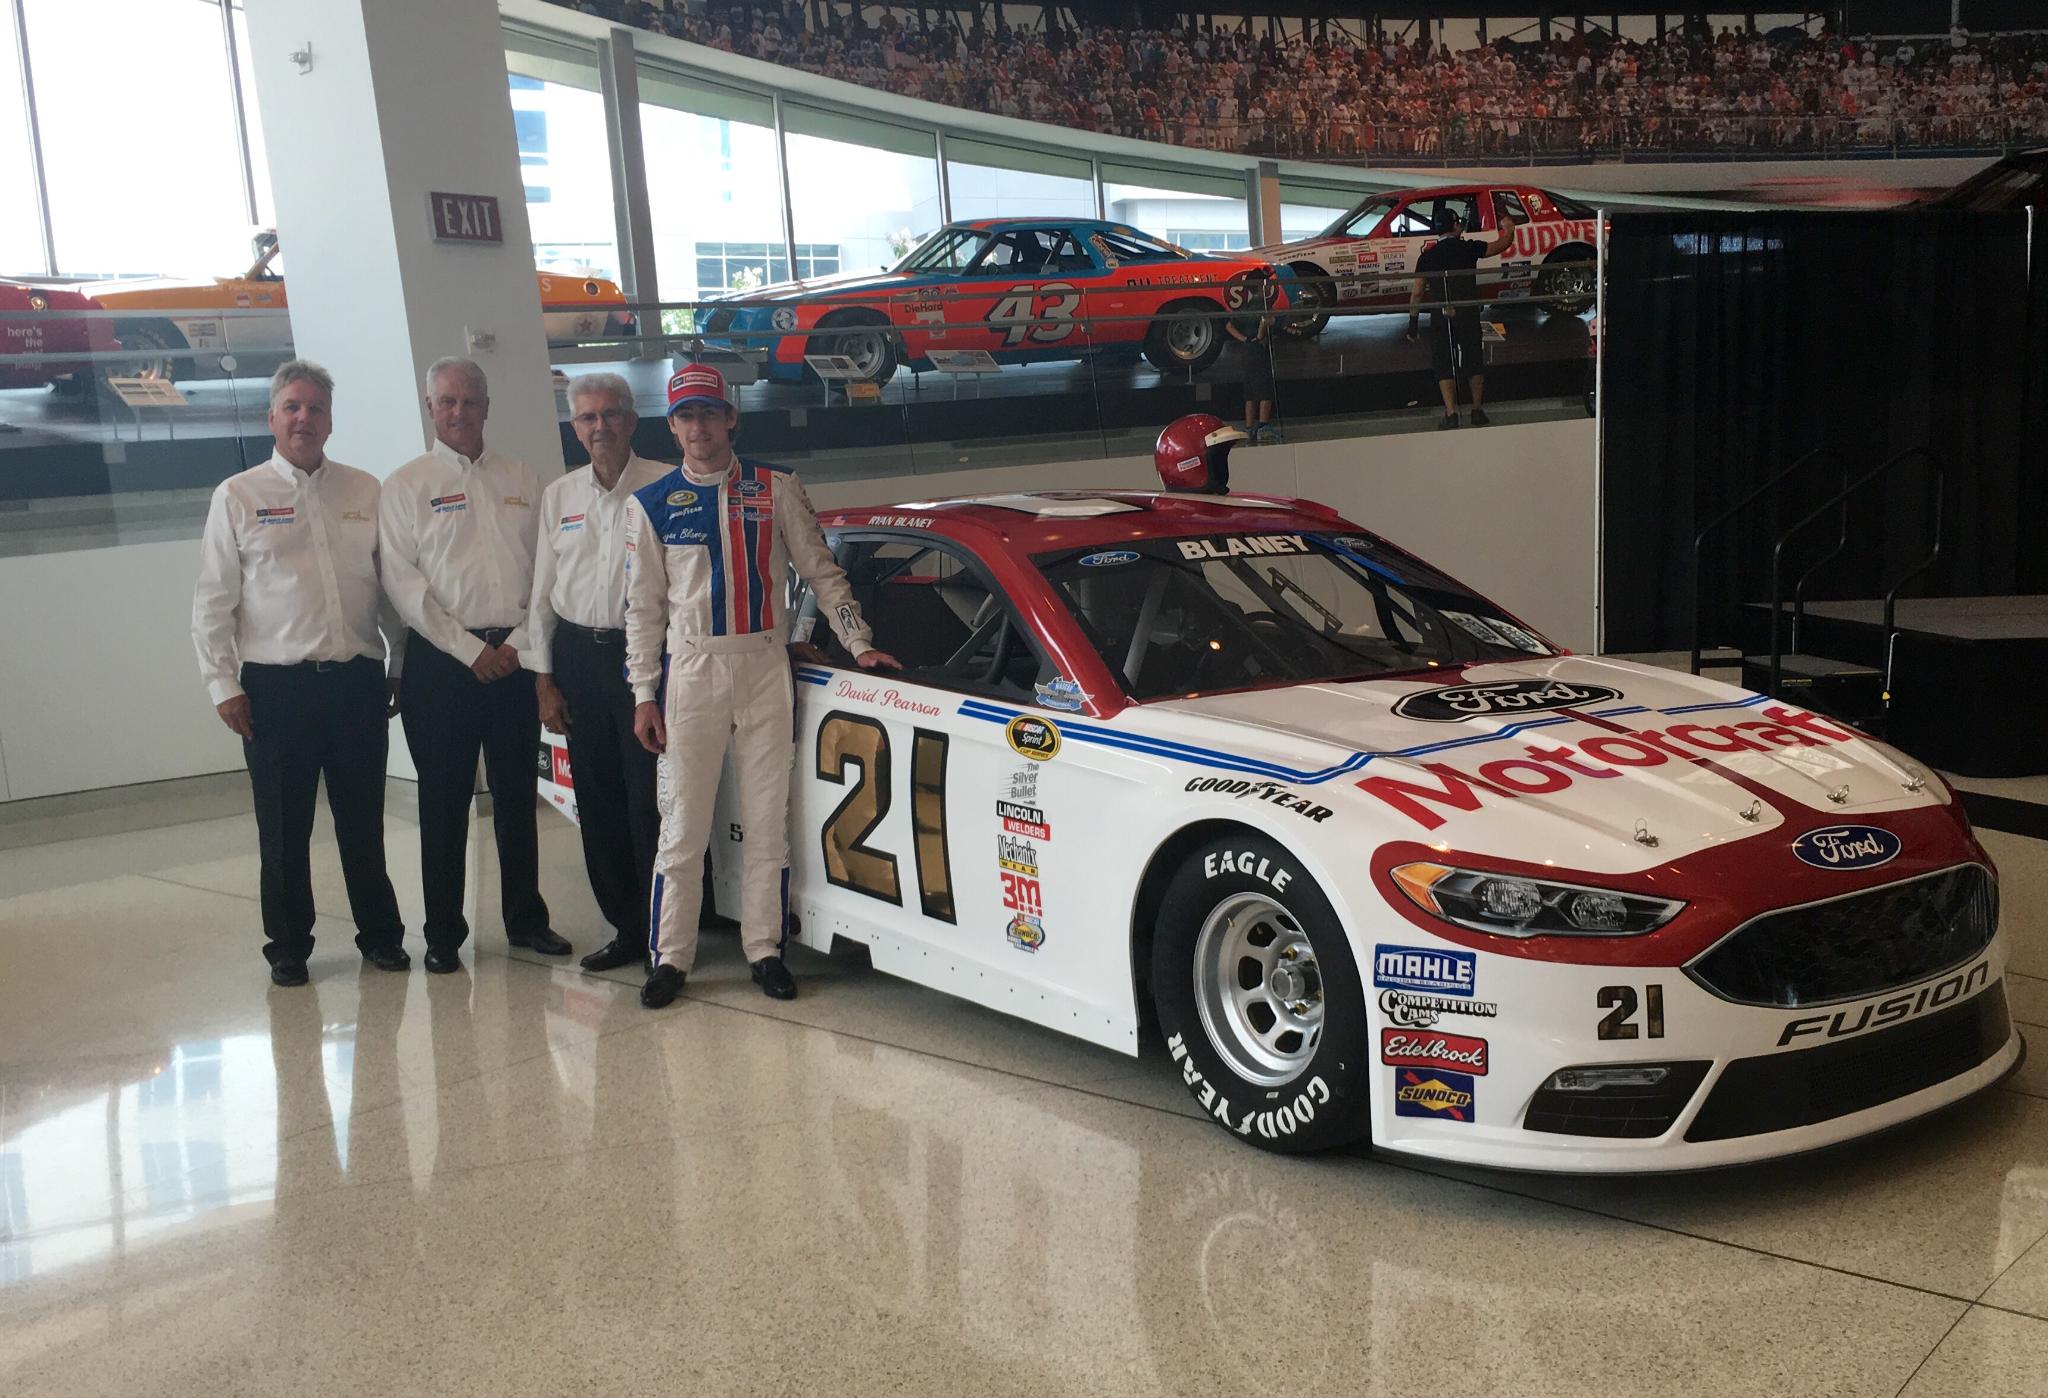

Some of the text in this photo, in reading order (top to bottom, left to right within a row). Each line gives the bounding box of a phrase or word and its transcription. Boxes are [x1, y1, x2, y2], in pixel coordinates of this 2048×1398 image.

[442, 199, 492, 237] EXIT
[904, 302, 944, 313] DieHard
[984, 283, 1081, 345] 43
[868, 515, 936, 529] RYAN BLANEY
[1092, 552, 1131, 565] Ford
[1176, 535, 1312, 561] BLANEY
[836, 680, 943, 718] David Pearson
[1437, 683, 1590, 713] Ford
[1021, 732, 1043, 746] Sprint
[1012, 771, 1039, 785] Silver
[1027, 762, 1040, 772] The
[1010, 783, 1037, 799] Bullet
[1184, 776, 1334, 824] GOODYEAR
[816, 709, 958, 926] 21
[998, 802, 1041, 825] LINCOLN
[1007, 820, 1046, 839] WELDERS
[997, 834, 1037, 867] Mechanix
[1812, 830, 1885, 863] Ford
[1001, 861, 1036, 875] WEAR
[1204, 850, 1293, 893] EAGLE
[1000, 871, 1043, 917] 3M
[1013, 927, 1040, 940] SUNOCO
[1378, 952, 1472, 982] MAHLE
[1379, 988, 1498, 1017] COMPETITION
[1390, 1004, 1442, 1028] CAMS
[1596, 983, 1665, 1041] 21
[1776, 961, 1990, 1047] FUSION
[1384, 1035, 1484, 1067] Edelbrock
[1167, 1031, 1331, 1140] GOODYEAR
[1400, 1085, 1471, 1106] SUNOCO
